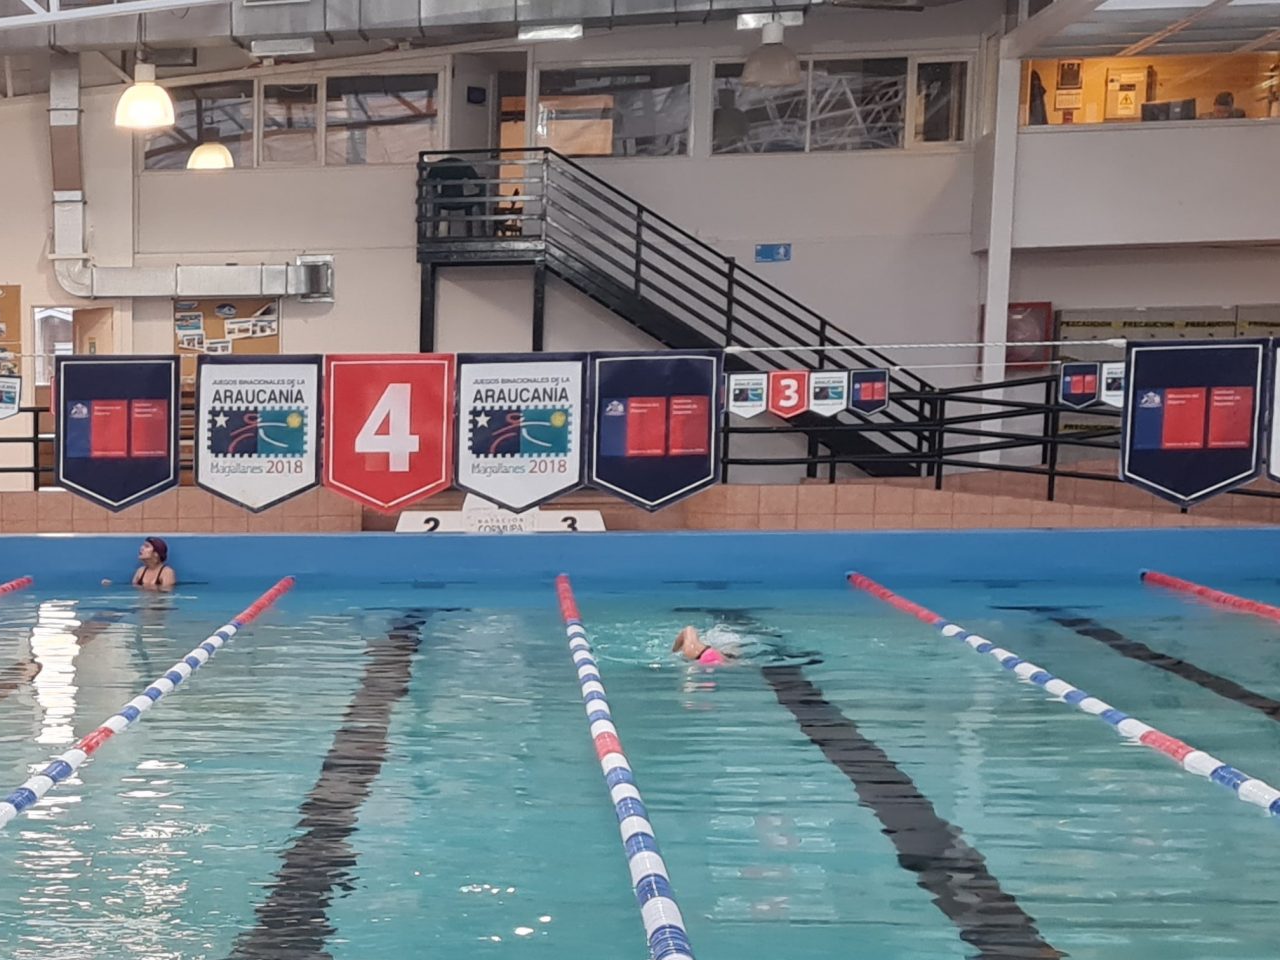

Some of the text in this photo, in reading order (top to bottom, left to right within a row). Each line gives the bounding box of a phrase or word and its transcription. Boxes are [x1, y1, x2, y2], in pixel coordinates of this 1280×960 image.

[212, 384, 305, 404] ARAUCANÍA
[473, 382, 569, 403] ARAUCANÍA
[779, 378, 800, 408] 3
[355, 383, 419, 472] 4
[265, 460, 303, 474] 2018
[528, 460, 567, 474] 2018
[423, 516, 440, 532] 2
